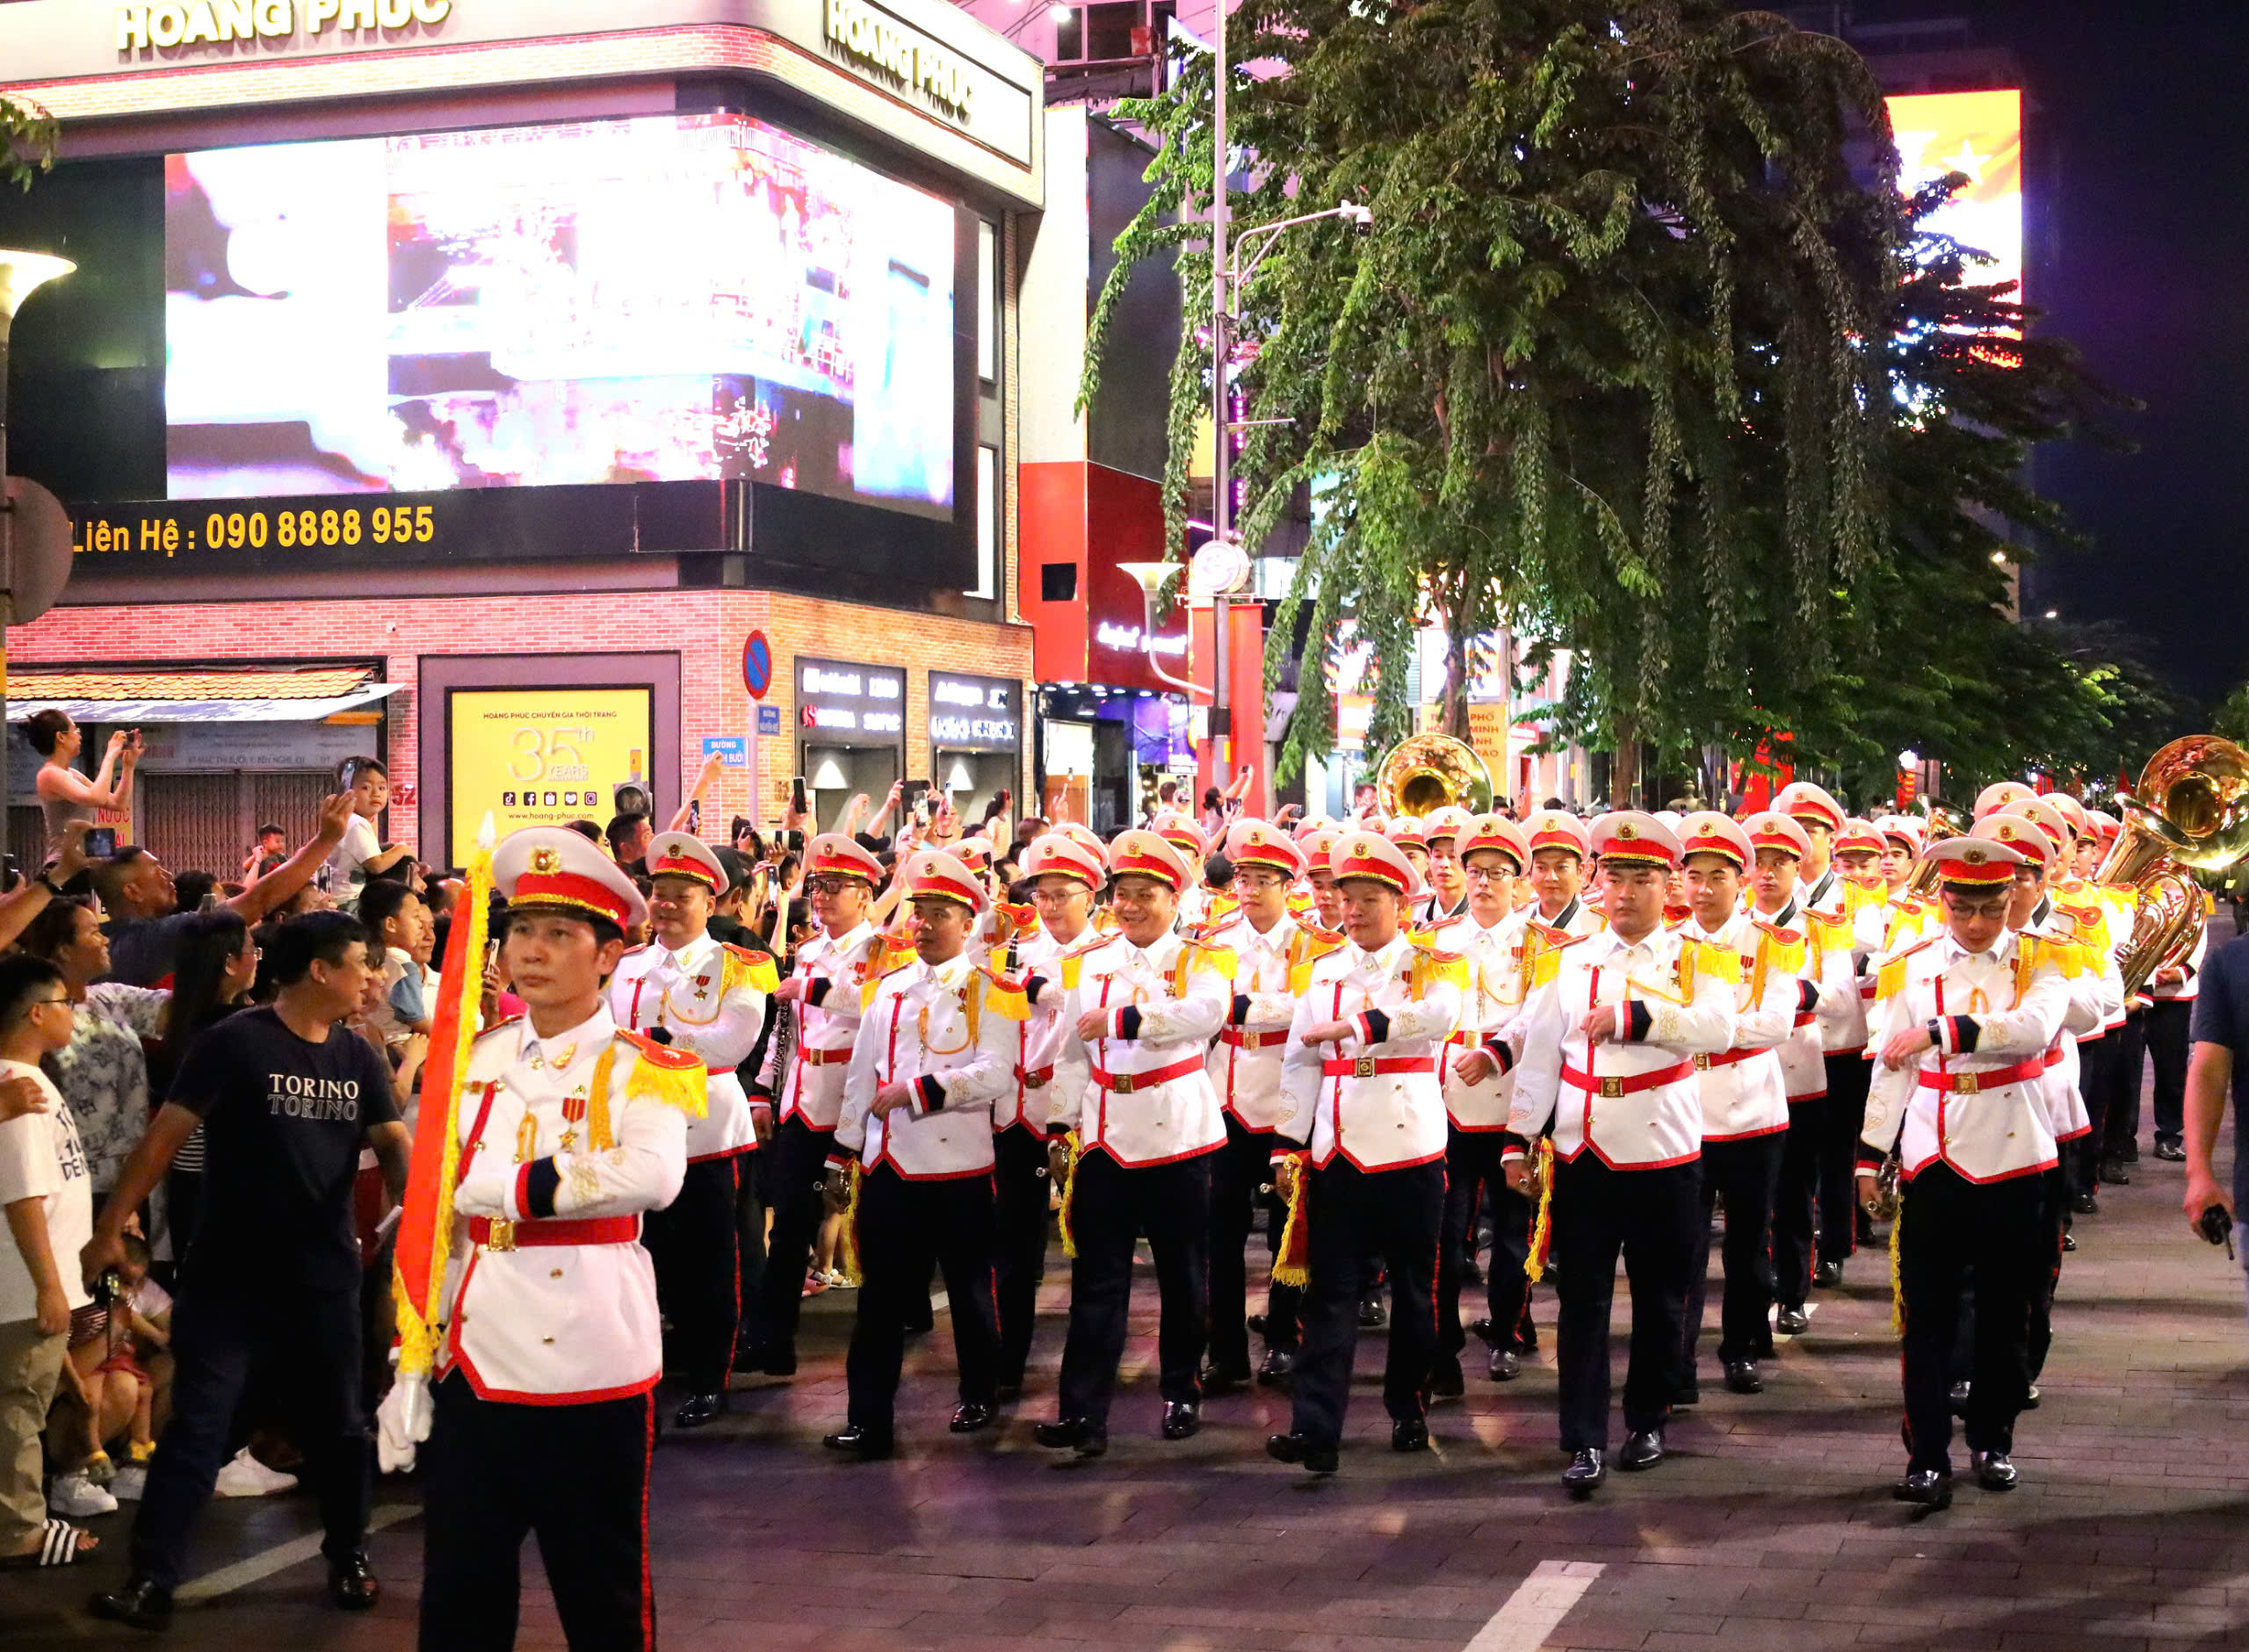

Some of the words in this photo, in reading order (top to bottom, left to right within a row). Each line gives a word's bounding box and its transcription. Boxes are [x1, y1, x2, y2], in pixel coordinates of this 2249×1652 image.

[70, 519, 129, 552] Liên
[141, 519, 179, 558] Hệ
[206, 512, 268, 549] 090
[278, 509, 362, 547] 8888
[372, 506, 434, 543] 955
[509, 812, 594, 820] www.hoang-phuc.com
[269, 1073, 359, 1100] TORINO
[267, 1093, 358, 1122] TORINO
